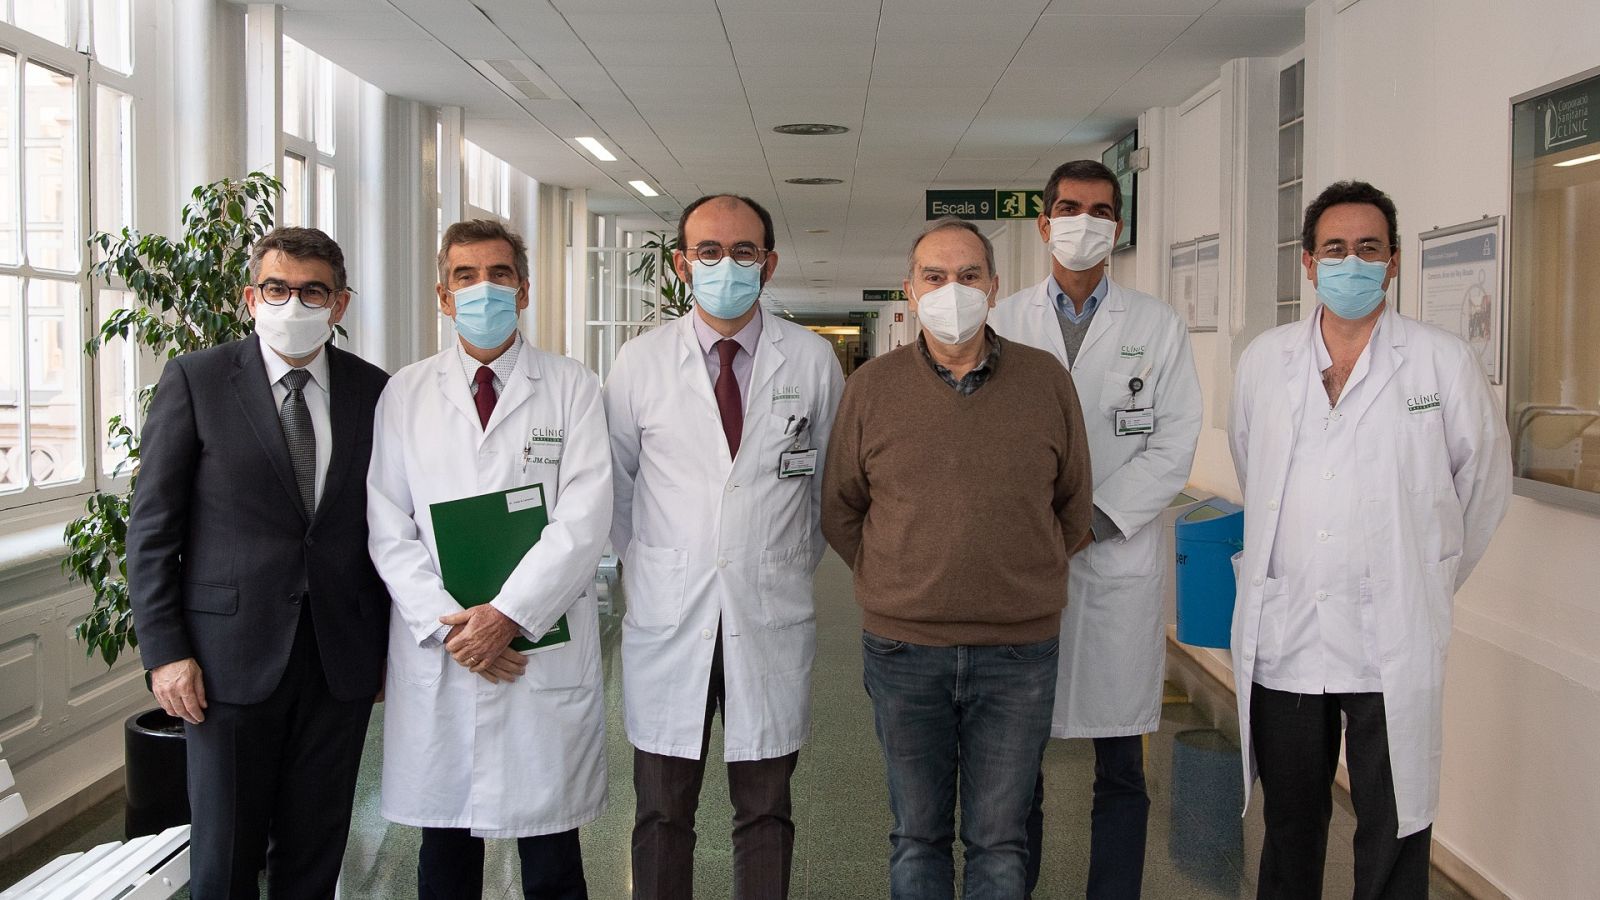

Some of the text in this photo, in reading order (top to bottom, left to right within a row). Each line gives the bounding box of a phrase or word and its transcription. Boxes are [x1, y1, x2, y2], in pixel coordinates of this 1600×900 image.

[932, 201, 990, 214] Escala 9
[531, 426, 564, 437] CLÍNIC
